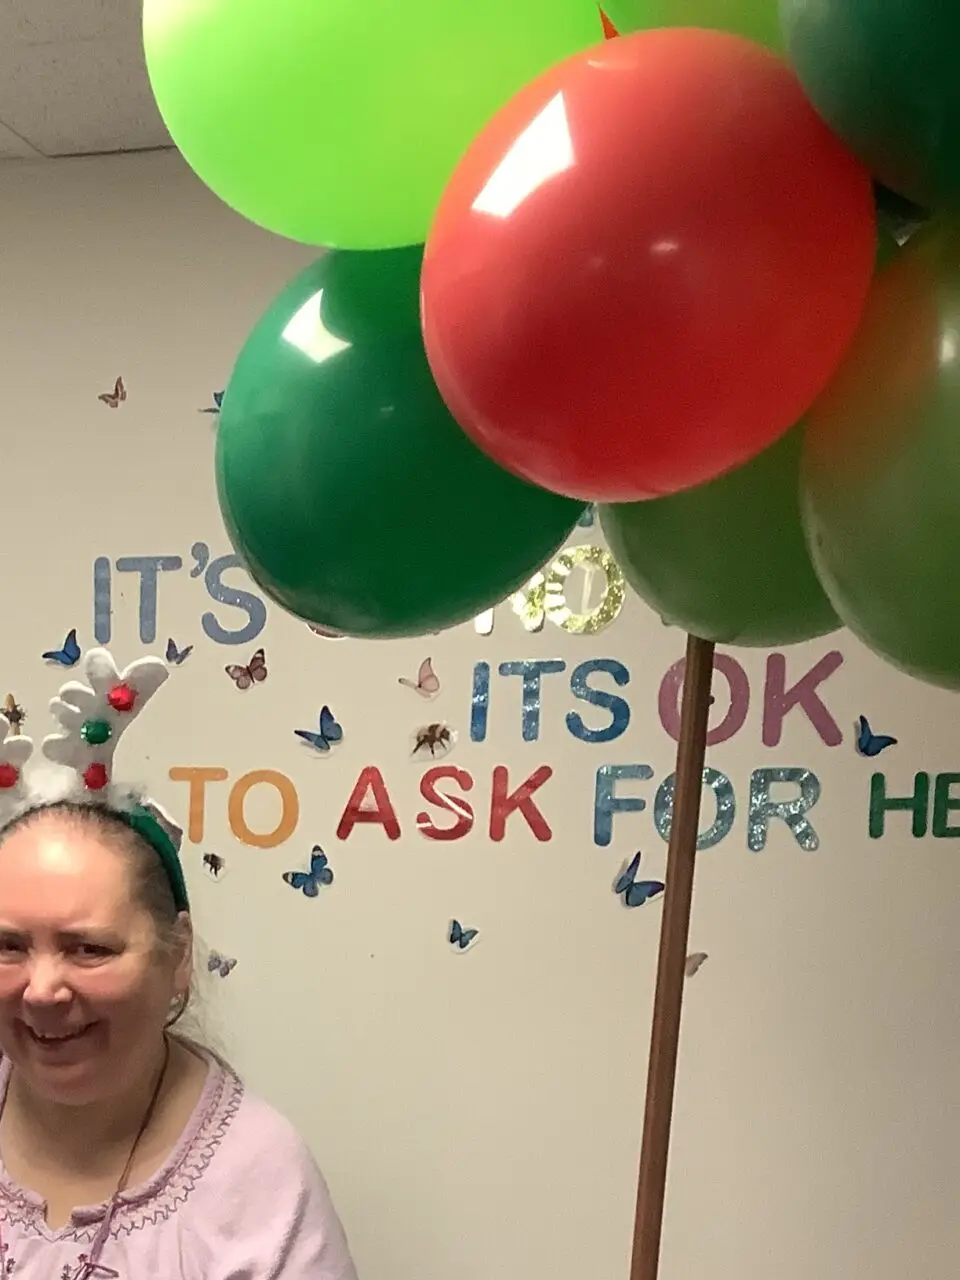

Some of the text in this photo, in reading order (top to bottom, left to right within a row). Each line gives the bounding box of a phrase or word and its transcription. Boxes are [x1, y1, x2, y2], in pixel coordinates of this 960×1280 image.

[94, 542, 267, 645] IT'S
[470, 650, 844, 747] ITS OK
[168, 766, 299, 849] TO
[336, 765, 553, 842] ASK
[593, 764, 822, 852] FOR
